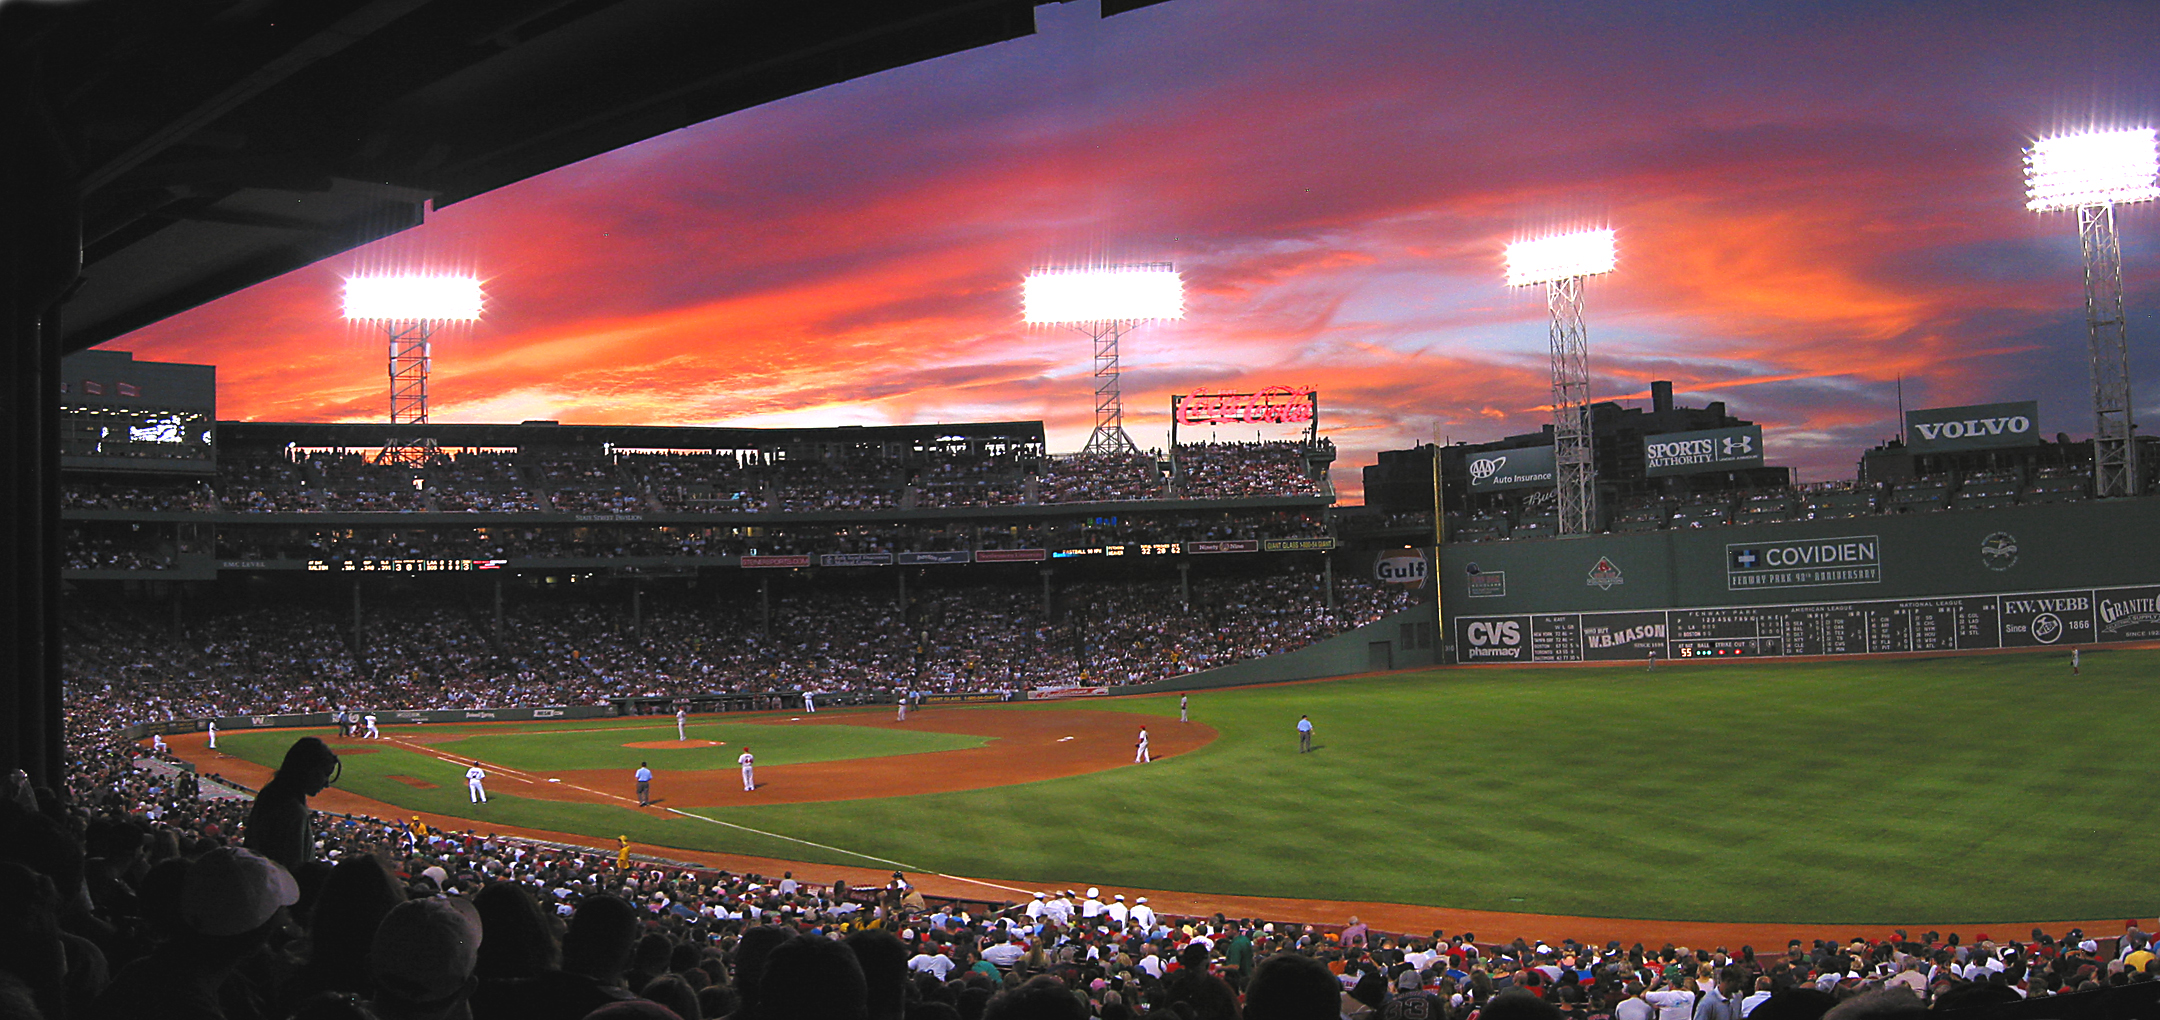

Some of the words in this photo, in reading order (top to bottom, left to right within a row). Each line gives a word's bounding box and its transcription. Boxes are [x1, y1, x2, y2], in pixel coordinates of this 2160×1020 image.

[1915, 416, 2029, 440] VOLVO
[1648, 439, 1712, 459] SPORTS
[1649, 454, 1712, 468] AUTHORITY
[1493, 476, 1512, 484] Auto
[1514, 473, 1552, 482] Insurance
[1766, 543, 1874, 566] COVIDIEN
[1378, 562, 1425, 578] Gulf
[1733, 575, 1766, 586] FENWAY
[1770, 574, 1792, 584] PARK
[1815, 570, 1876, 581] ANNIVERSARY
[2037, 598, 2089, 612] WEBB
[2101, 599, 2154, 623] GRANITE
[1468, 621, 1520, 646] CVS
[2006, 625, 2027, 633] Since
[2069, 621, 2090, 629] 1866
[1469, 647, 1520, 658] pharmacy
[1681, 648, 1692, 657] 55
